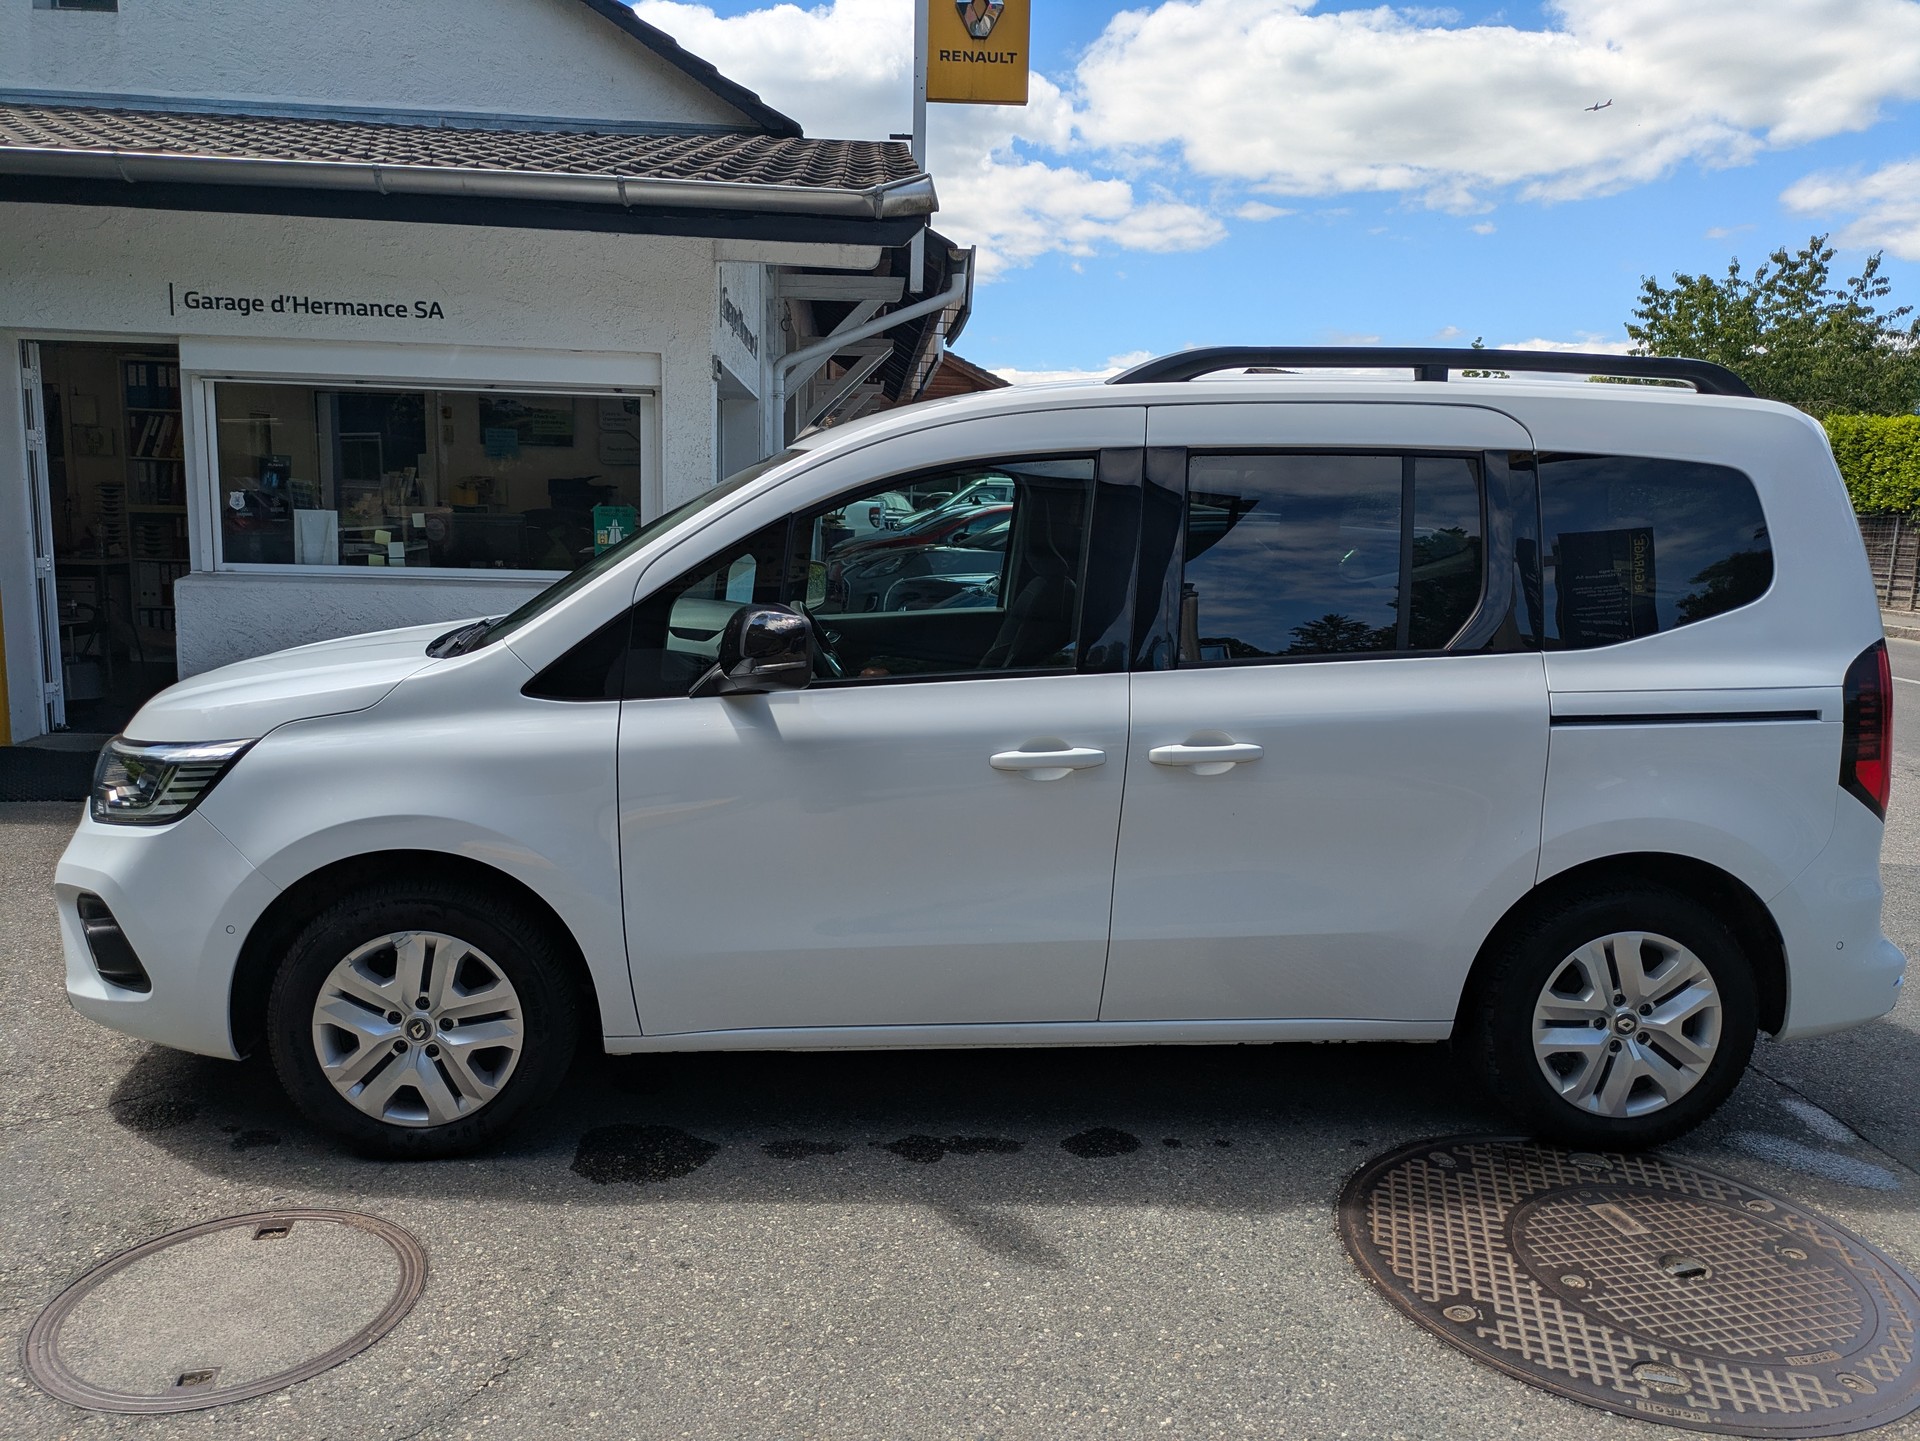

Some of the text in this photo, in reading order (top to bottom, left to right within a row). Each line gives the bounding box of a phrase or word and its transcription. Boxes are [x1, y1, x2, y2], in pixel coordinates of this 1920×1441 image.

[940, 50, 1017, 64] RENAULT
[183, 290, 445, 320] Garage d'Hermance SA
